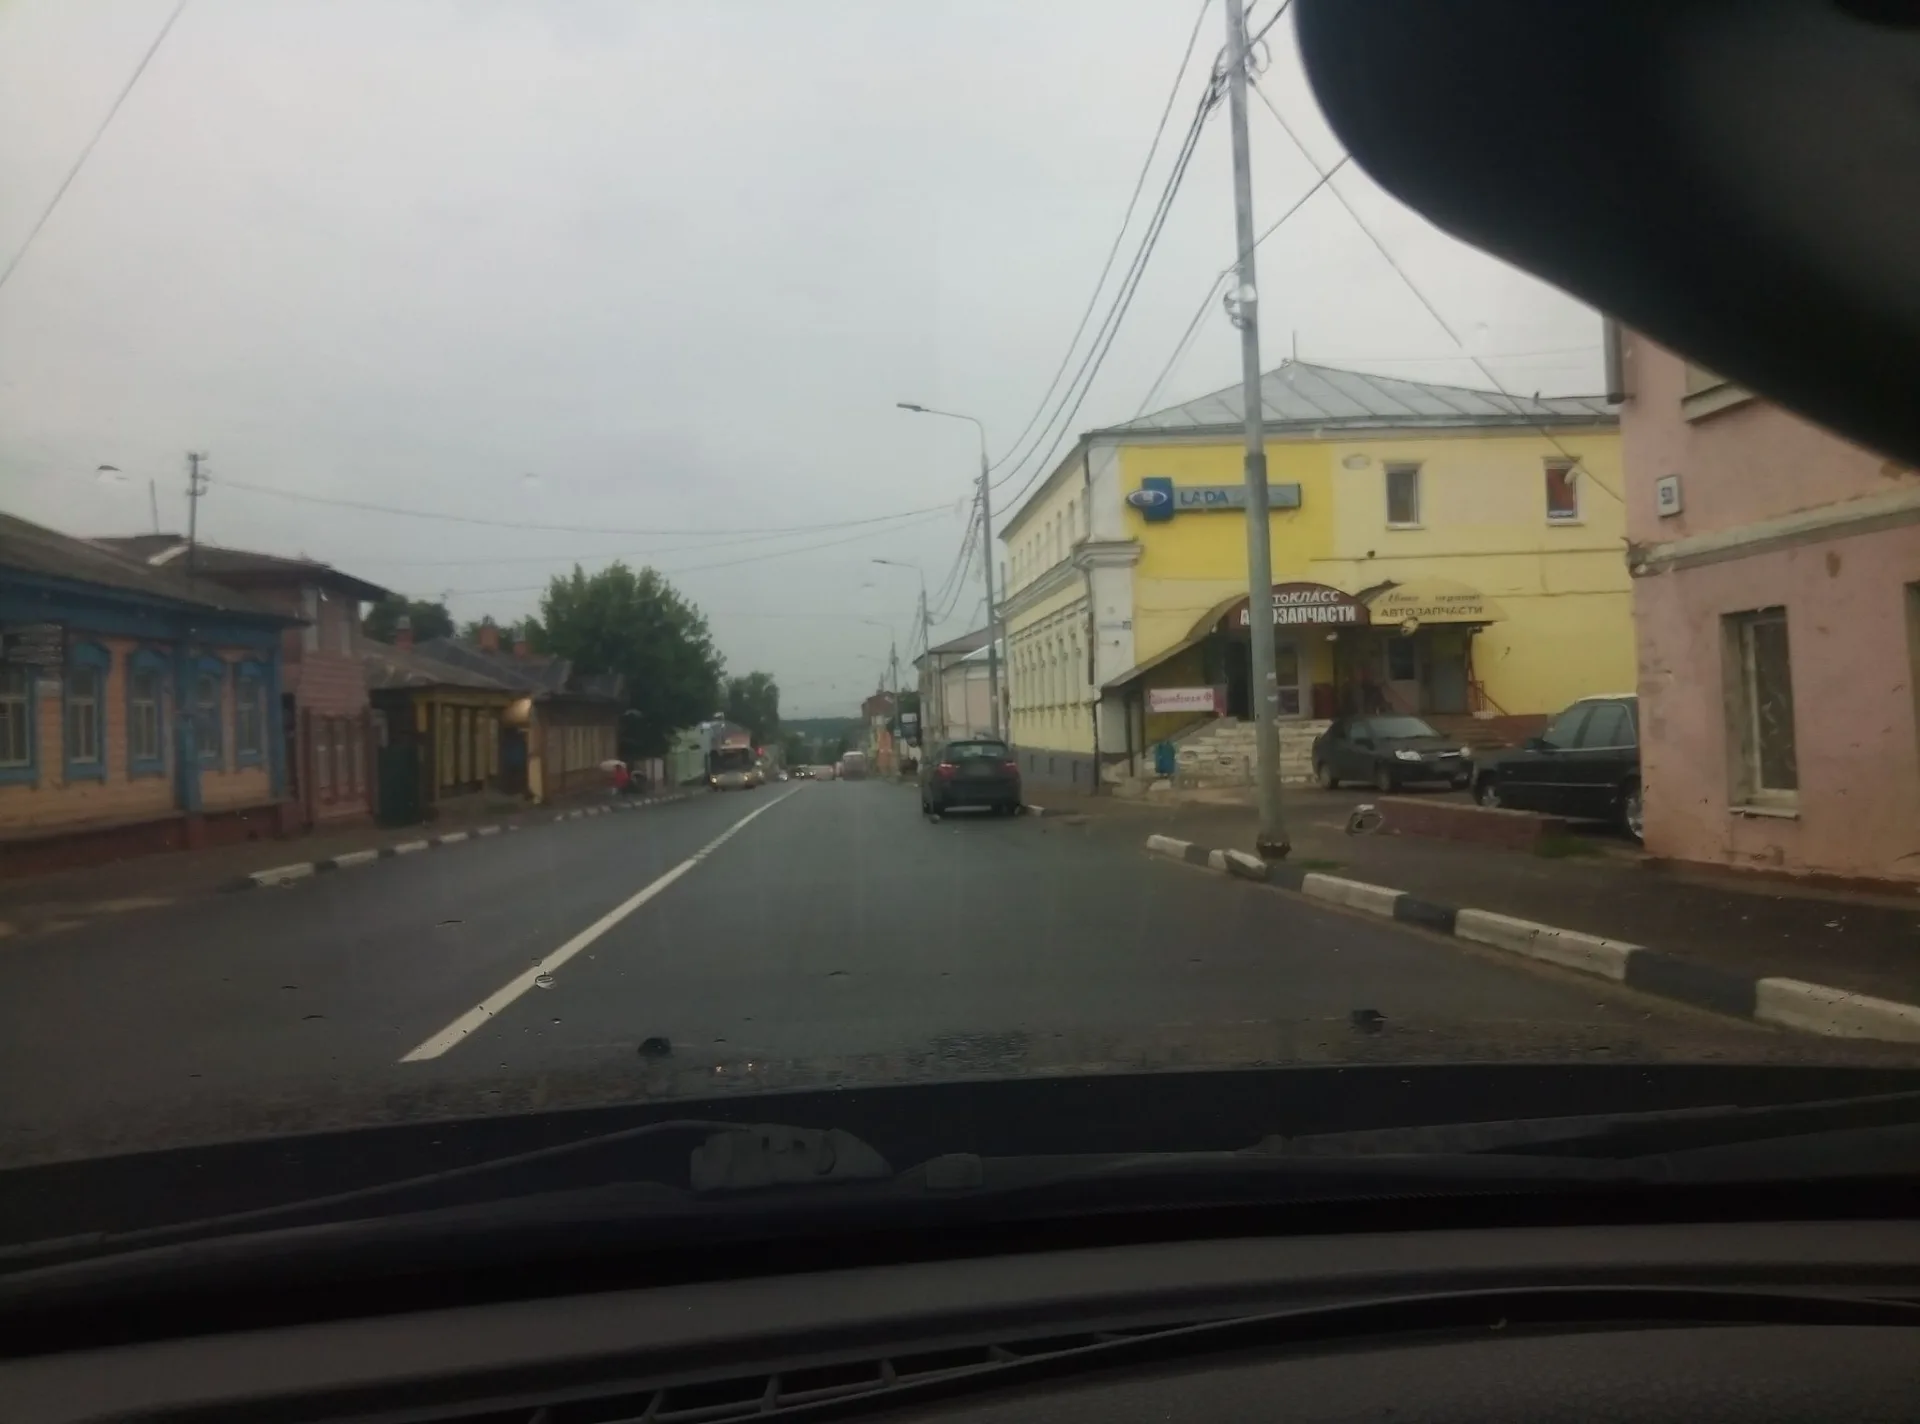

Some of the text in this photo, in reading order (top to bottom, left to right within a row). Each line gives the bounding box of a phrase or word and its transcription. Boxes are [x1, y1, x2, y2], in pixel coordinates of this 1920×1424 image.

[1179, 490, 1229, 506] LADA
[1271, 591, 1341, 604] тоКЛАСС
[1239, 606, 1356, 626] АЗАПЧАСТИ
